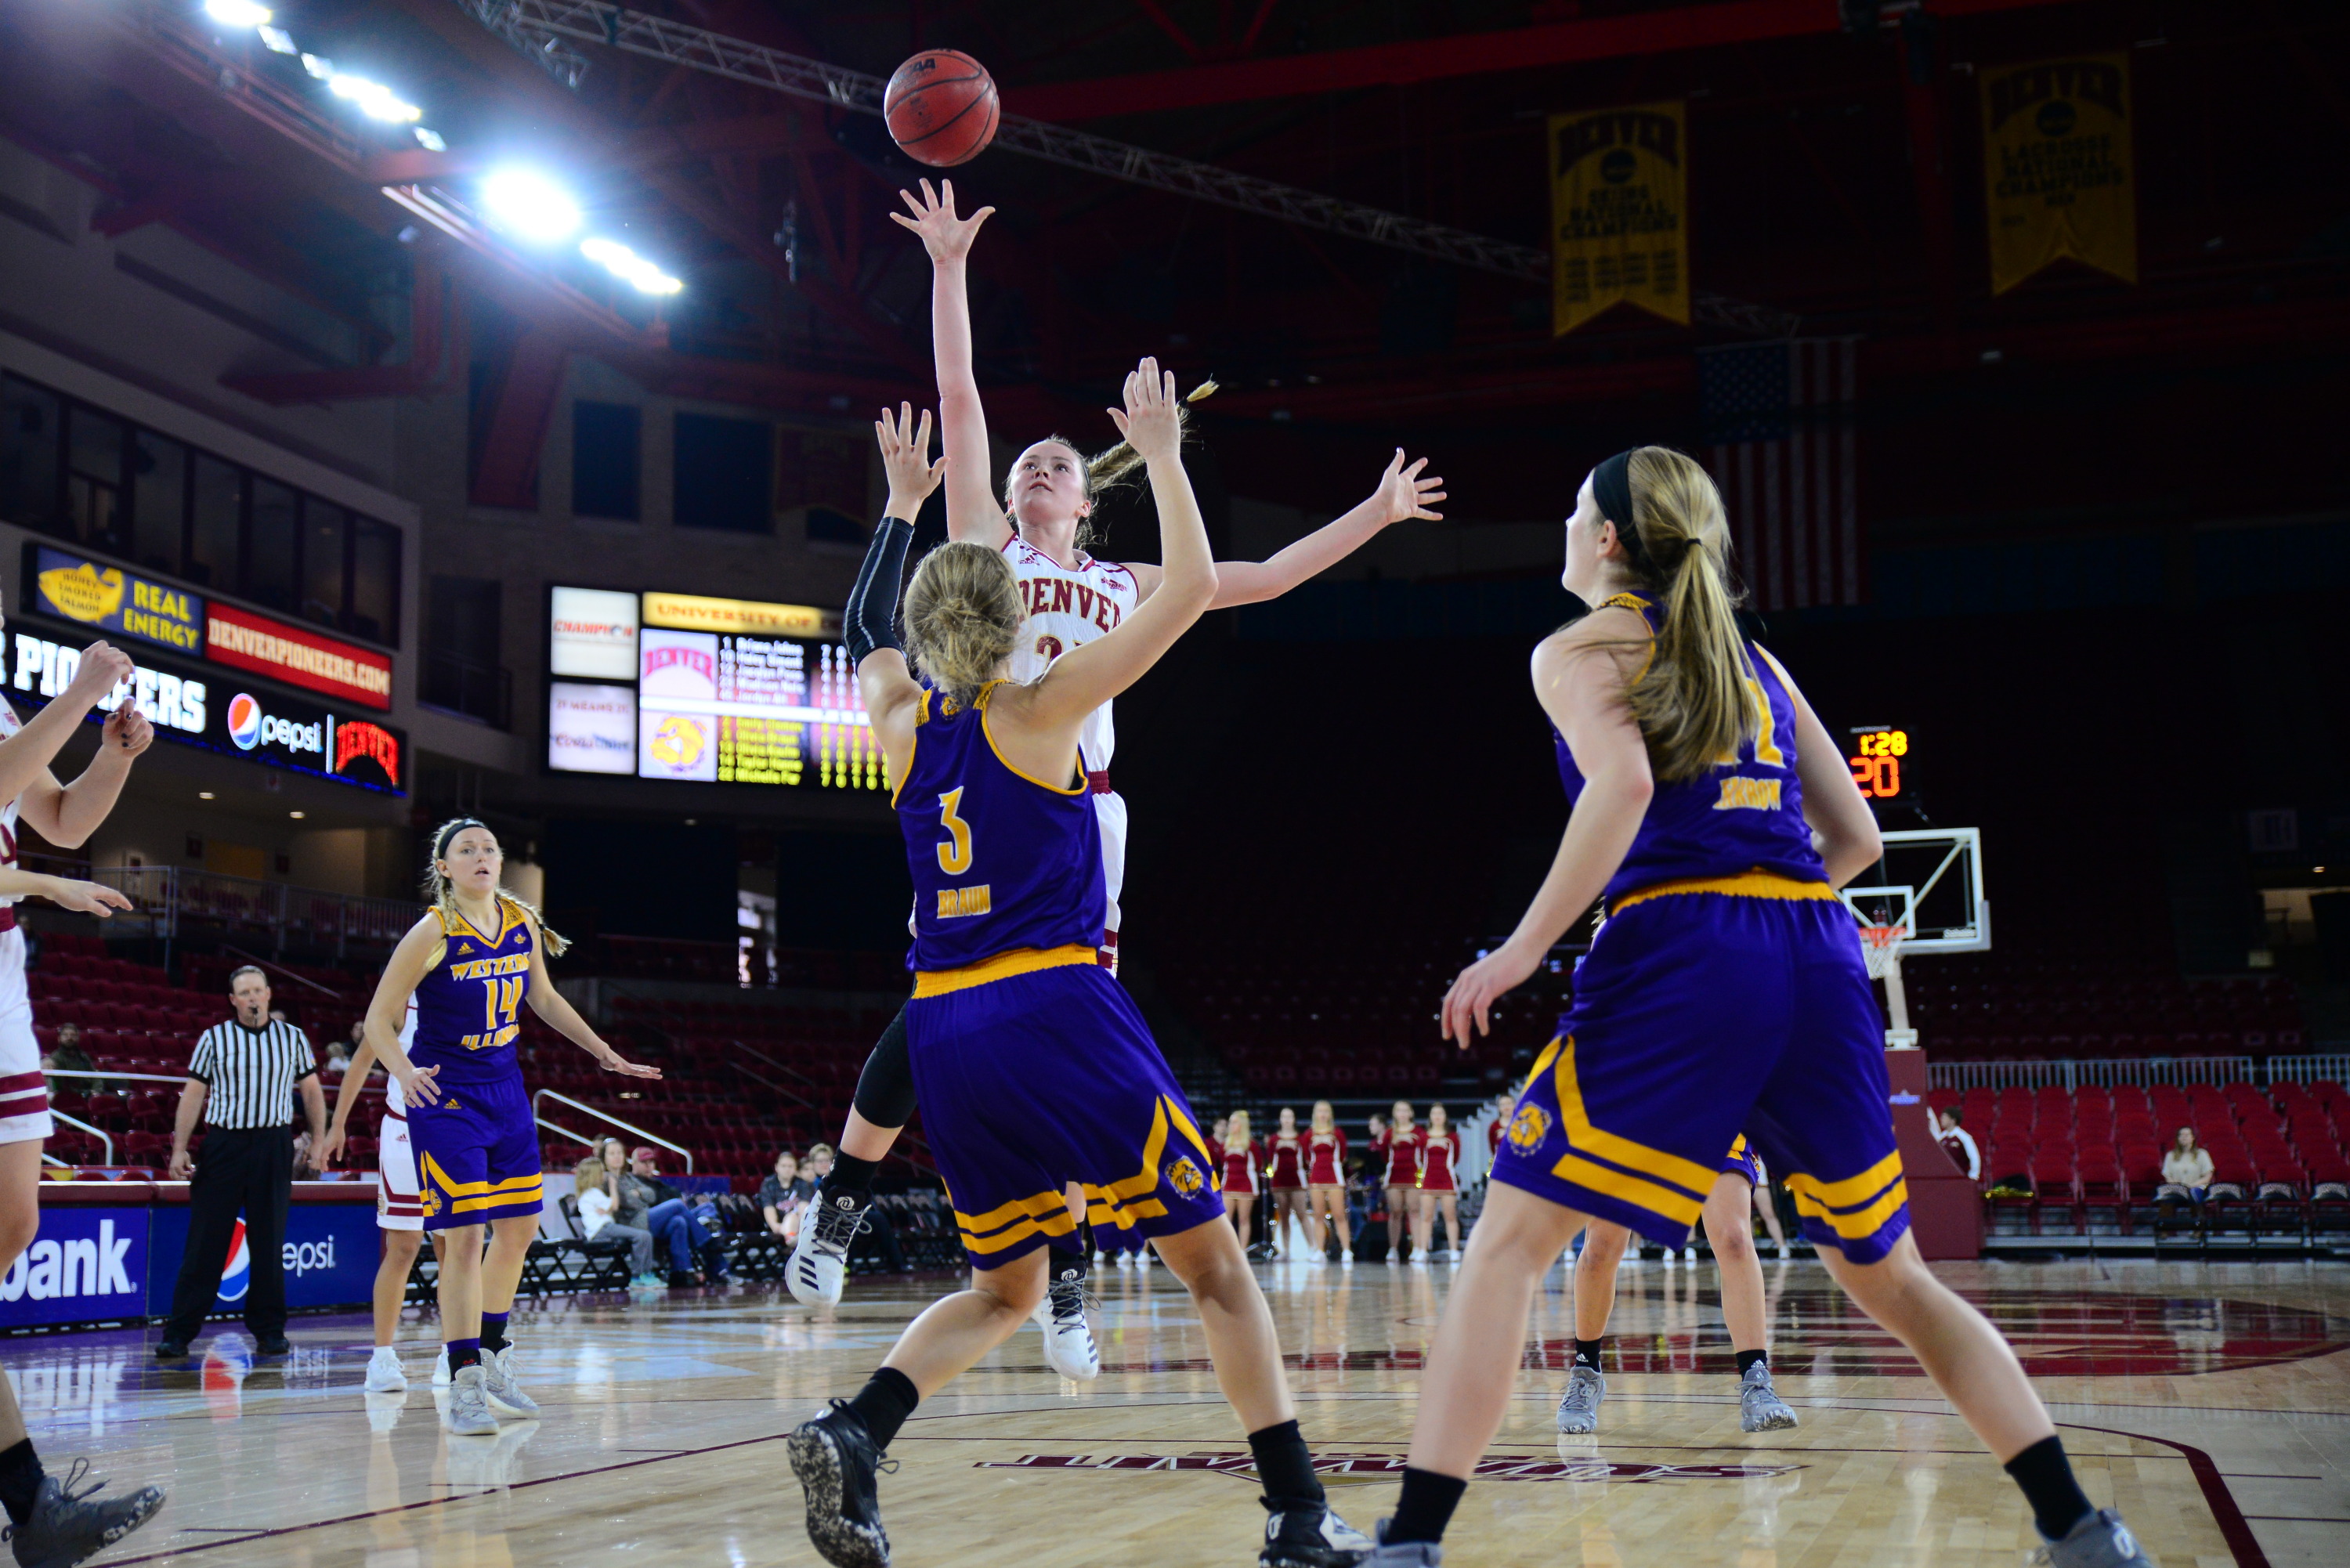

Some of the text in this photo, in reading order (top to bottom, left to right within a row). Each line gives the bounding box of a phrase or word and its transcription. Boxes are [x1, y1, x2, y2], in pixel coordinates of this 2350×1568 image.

[59, 582, 102, 602] SMOKED
[63, 572, 98, 590] HONEY
[60, 594, 99, 612] SALMON
[133, 580, 191, 623] REAL
[657, 604, 777, 626] UNIVERSITY
[785, 615, 811, 627] OF
[123, 607, 199, 649] ENERGY
[208, 617, 391, 696] DENVERPIONEERS.COM
[645, 647, 713, 682] DENVER
[14, 633, 206, 733] PIOEERS
[261, 714, 322, 753] pepsi
[1860, 731, 1907, 756] 1:28
[1849, 756, 1900, 797] 20
[936, 786, 973, 876] 3
[936, 884, 992, 919] BRAUN
[482, 975, 524, 1031] 14
[281, 1234, 334, 1277] epsi
